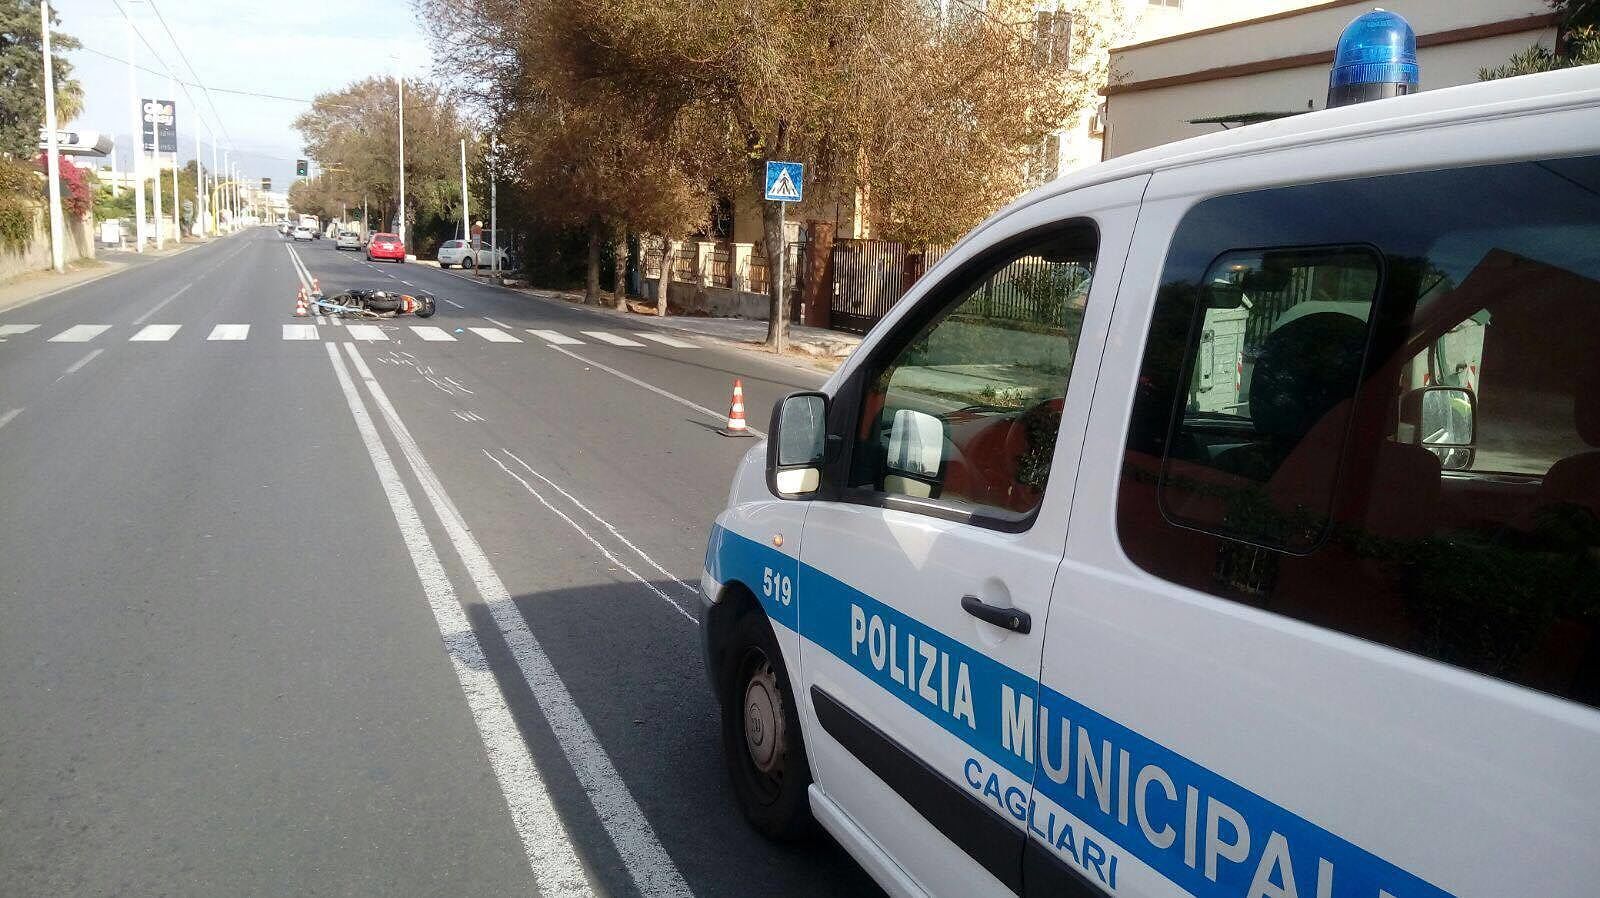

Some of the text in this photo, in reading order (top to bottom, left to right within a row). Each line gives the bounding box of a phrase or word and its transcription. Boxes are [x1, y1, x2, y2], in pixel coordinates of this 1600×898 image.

[763, 566, 792, 606] 519
[851, 603, 1400, 898] POLIZIA MUNICIPA
[964, 757, 1119, 891] CAGLIARI
